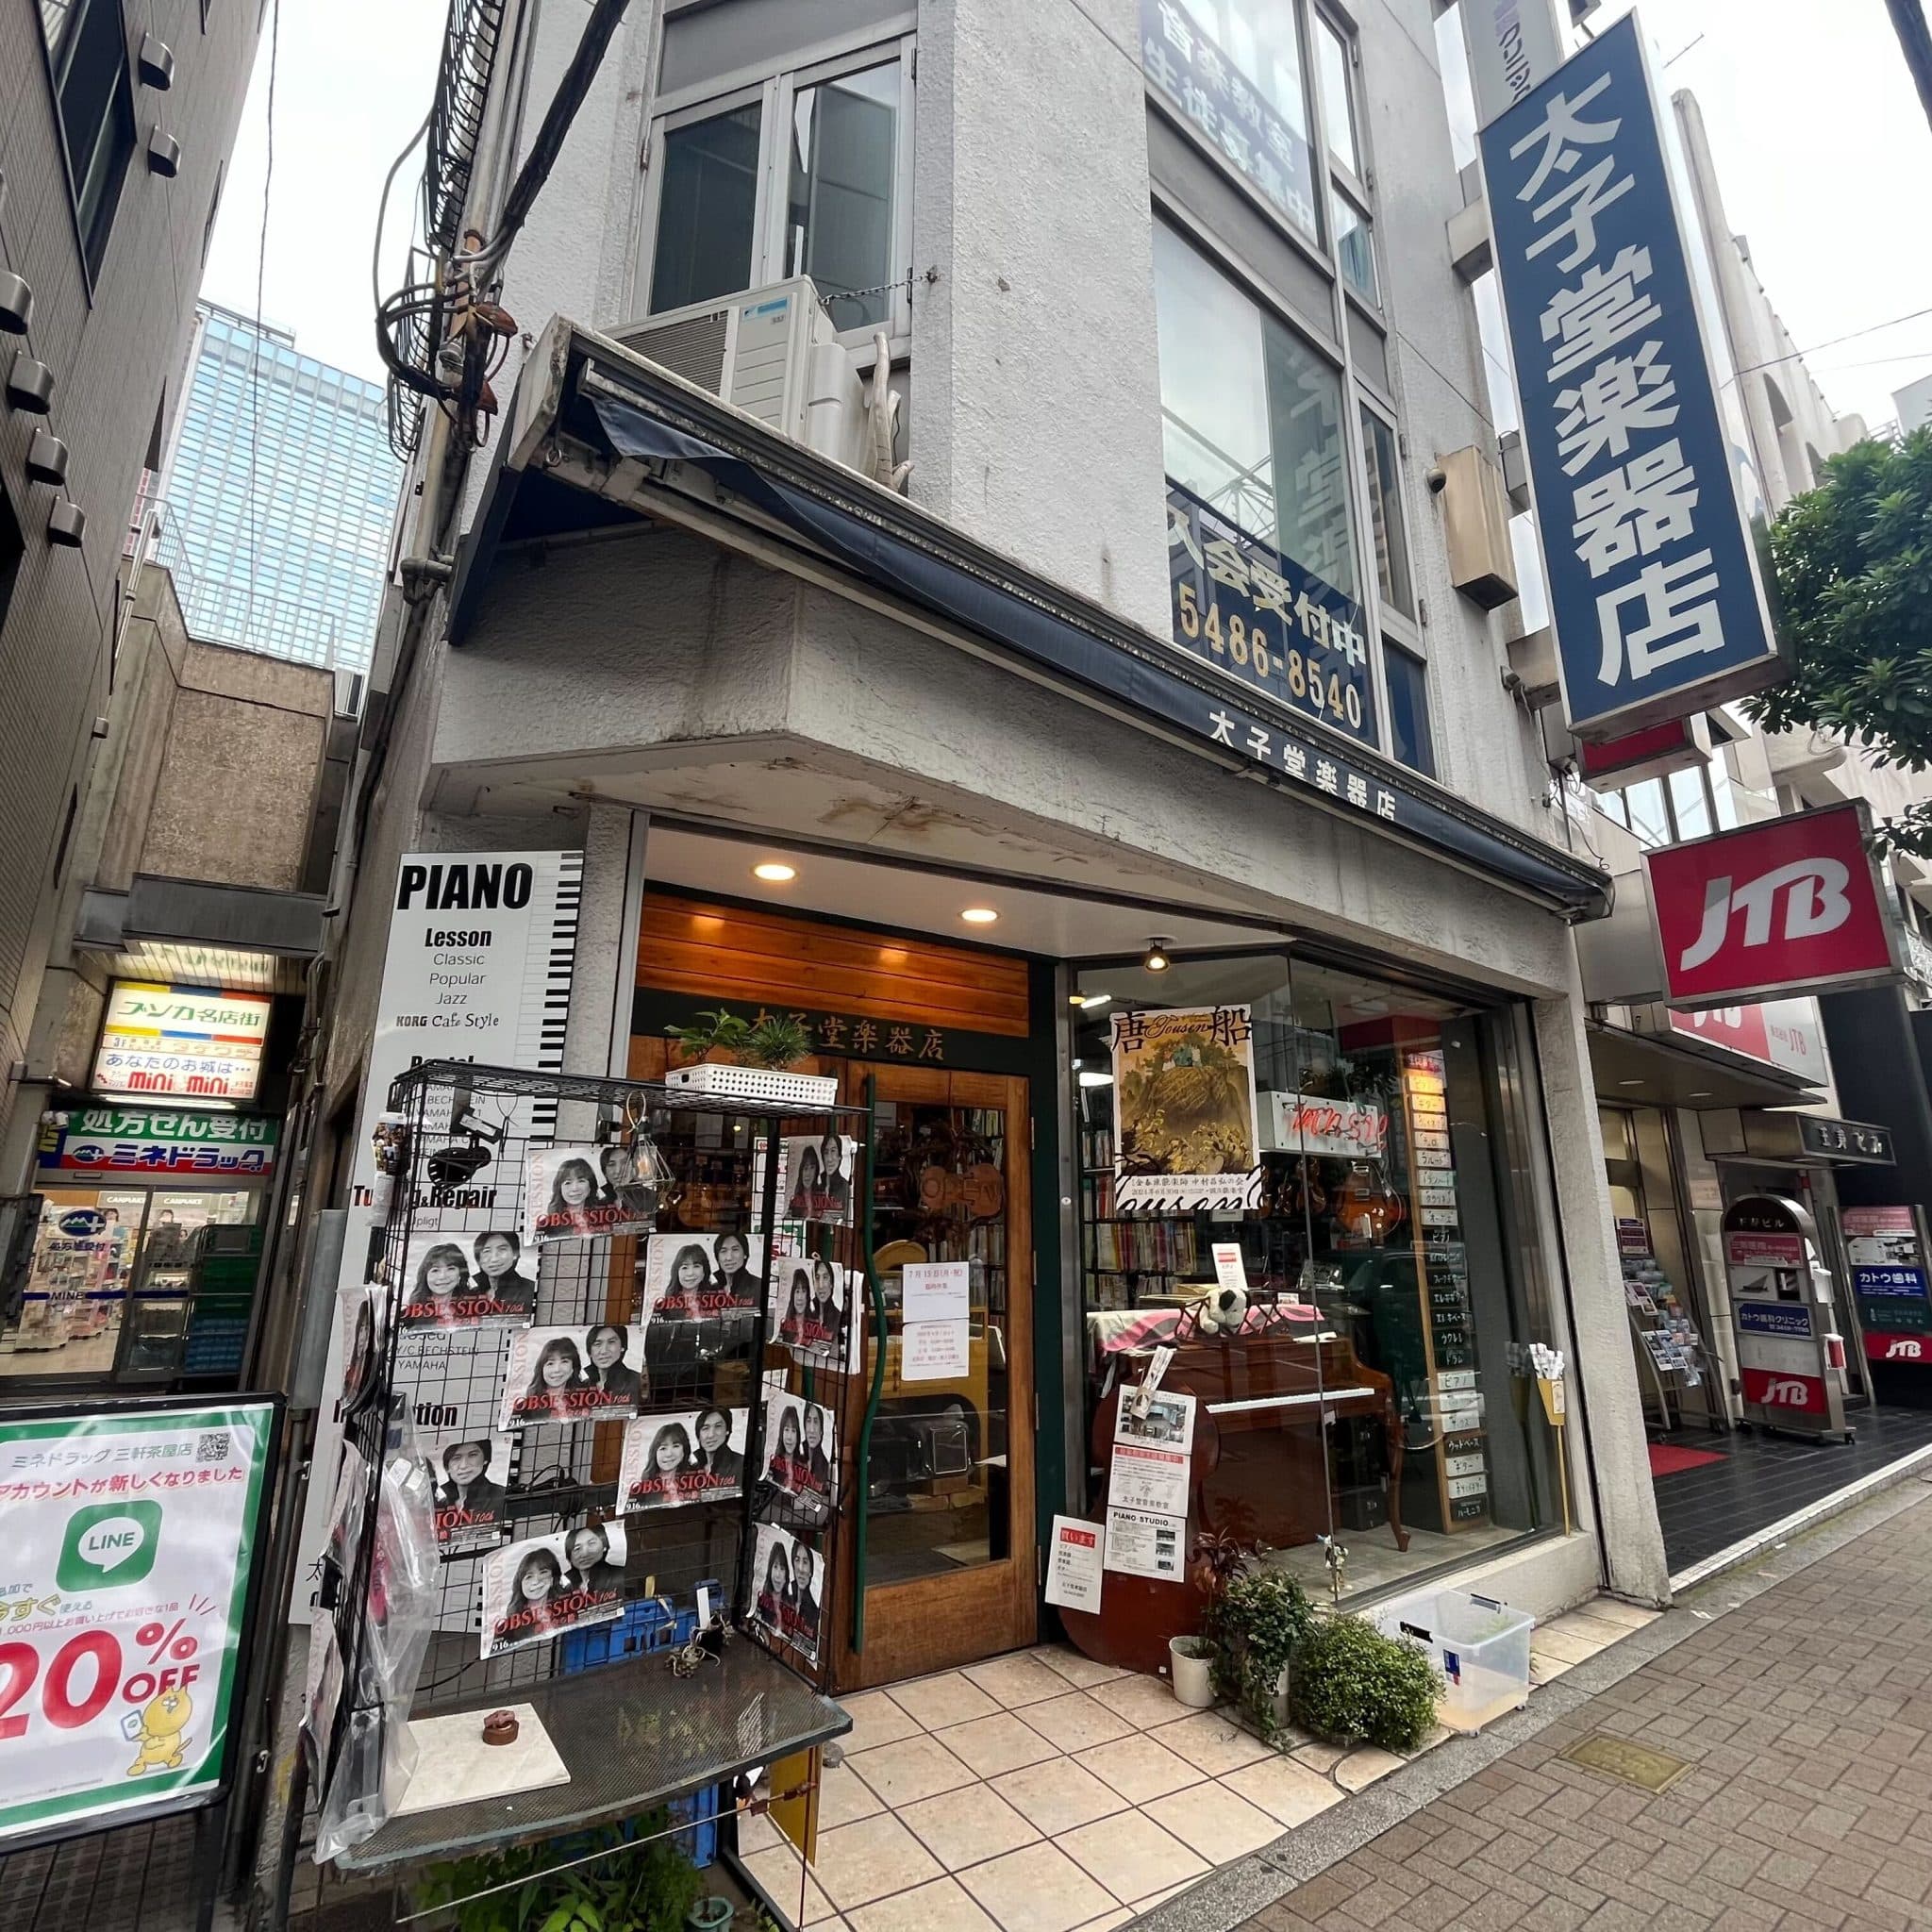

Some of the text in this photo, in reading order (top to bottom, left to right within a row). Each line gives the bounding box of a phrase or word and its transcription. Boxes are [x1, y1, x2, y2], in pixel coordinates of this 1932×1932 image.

[1510, 72, 1726, 687] 太子堂楽器店
[1178, 582, 1361, 729] 5486-8540
[1208, 710, 1396, 822] 太子堂楽器店
[396, 862, 534, 910] PIANO
[1680, 857, 1851, 972] JTB
[425, 928, 492, 947] Lesson
[433, 953, 485, 966] Classic
[429, 973, 487, 988] Popular
[435, 992, 469, 1005] Jazz
[396, 1015, 427, 1027] KORG
[465, 1013, 499, 1027] Style
[1112, 1011, 1146, 1054] 唐
[1209, 1006, 1253, 1047] 船
[128, 1072, 174, 1091] mini
[186, 1075, 229, 1094] mini
[81, 1109, 268, 1141] 処方せん受付
[108, 1143, 265, 1172] ミネドラッグ
[1859, 1272, 1917, 1285] カトウ歯科
[50, 1291, 85, 1301] MINE
[1886, 1340, 1923, 1358] JTB
[398, 1360, 447, 1371] YAMAHA
[513, 1390, 613, 1411] OBSESSION
[1760, 1379, 1809, 1406] JTB
[12, 1443, 193, 1469] ミネドラッグ 三軒茶屋店
[0, 1467, 244, 1502] アカウントが新しくなりました
[629, 1473, 720, 1495] OBSESSION
[1113, 1511, 1169, 1526] PIANO STUDIO
[89, 1530, 136, 1552] LINE
[494, 1591, 598, 1635] OBSESSION
[136, 1618, 197, 1666] %
[123, 1663, 200, 1705] OFF
